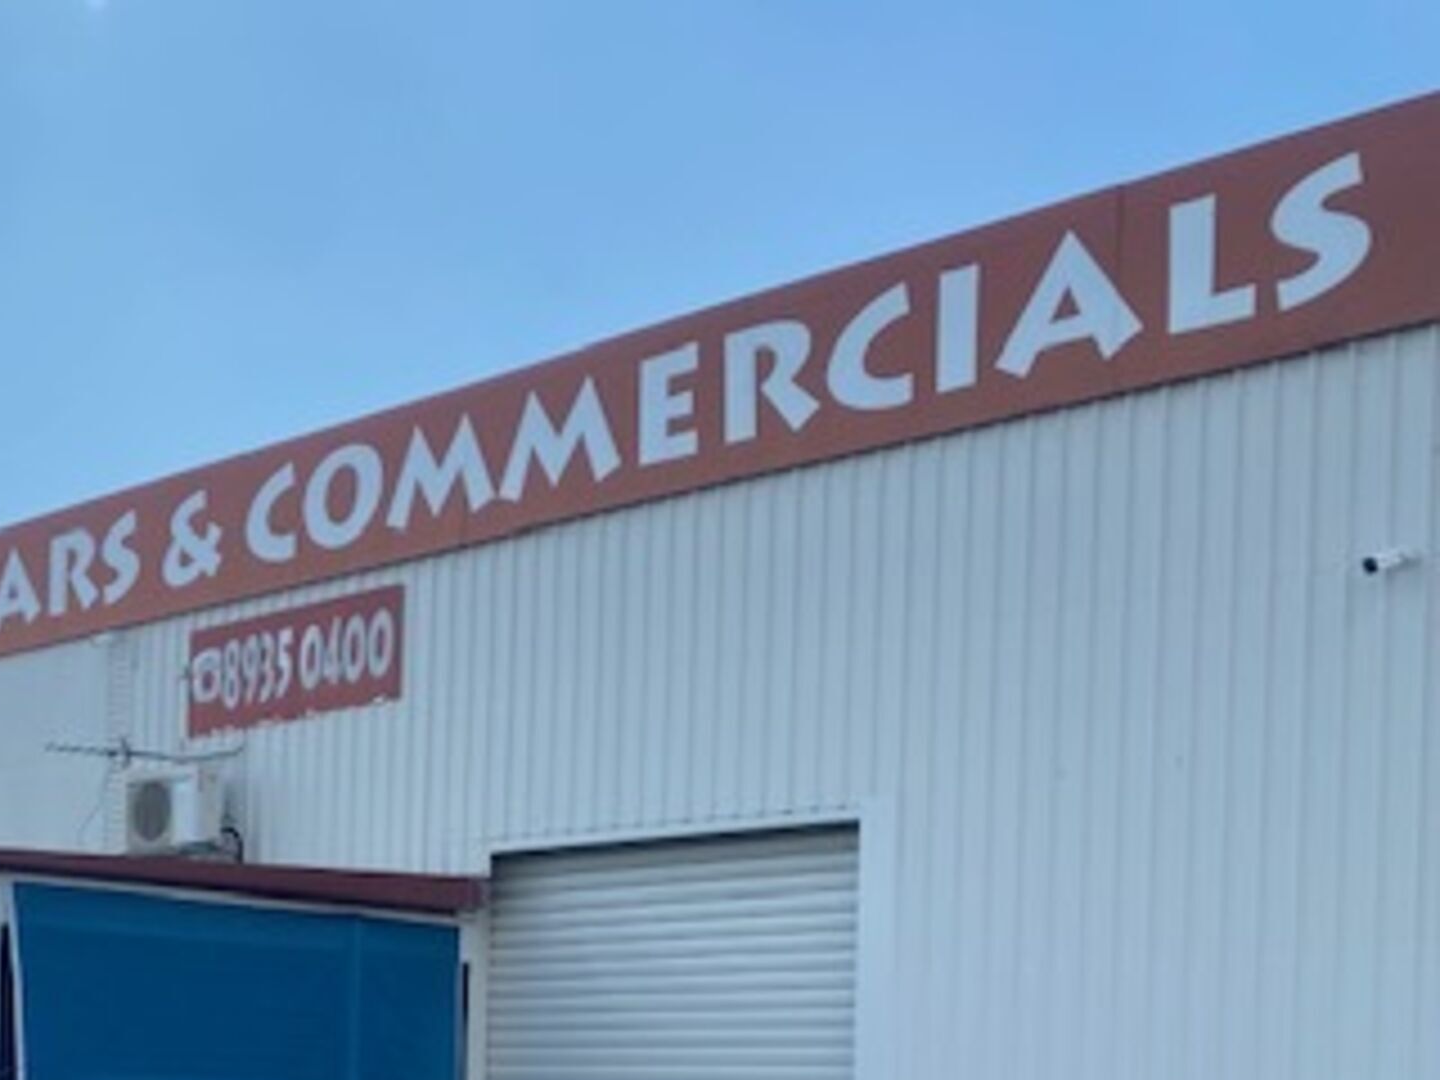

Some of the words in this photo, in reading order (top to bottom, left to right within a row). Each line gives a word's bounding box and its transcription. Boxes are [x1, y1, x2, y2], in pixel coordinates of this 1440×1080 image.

[163, 489, 222, 588] &
[245, 151, 1372, 563] COMMERCIALS
[223, 626, 294, 709] 8935
[299, 607, 394, 691] 0400
